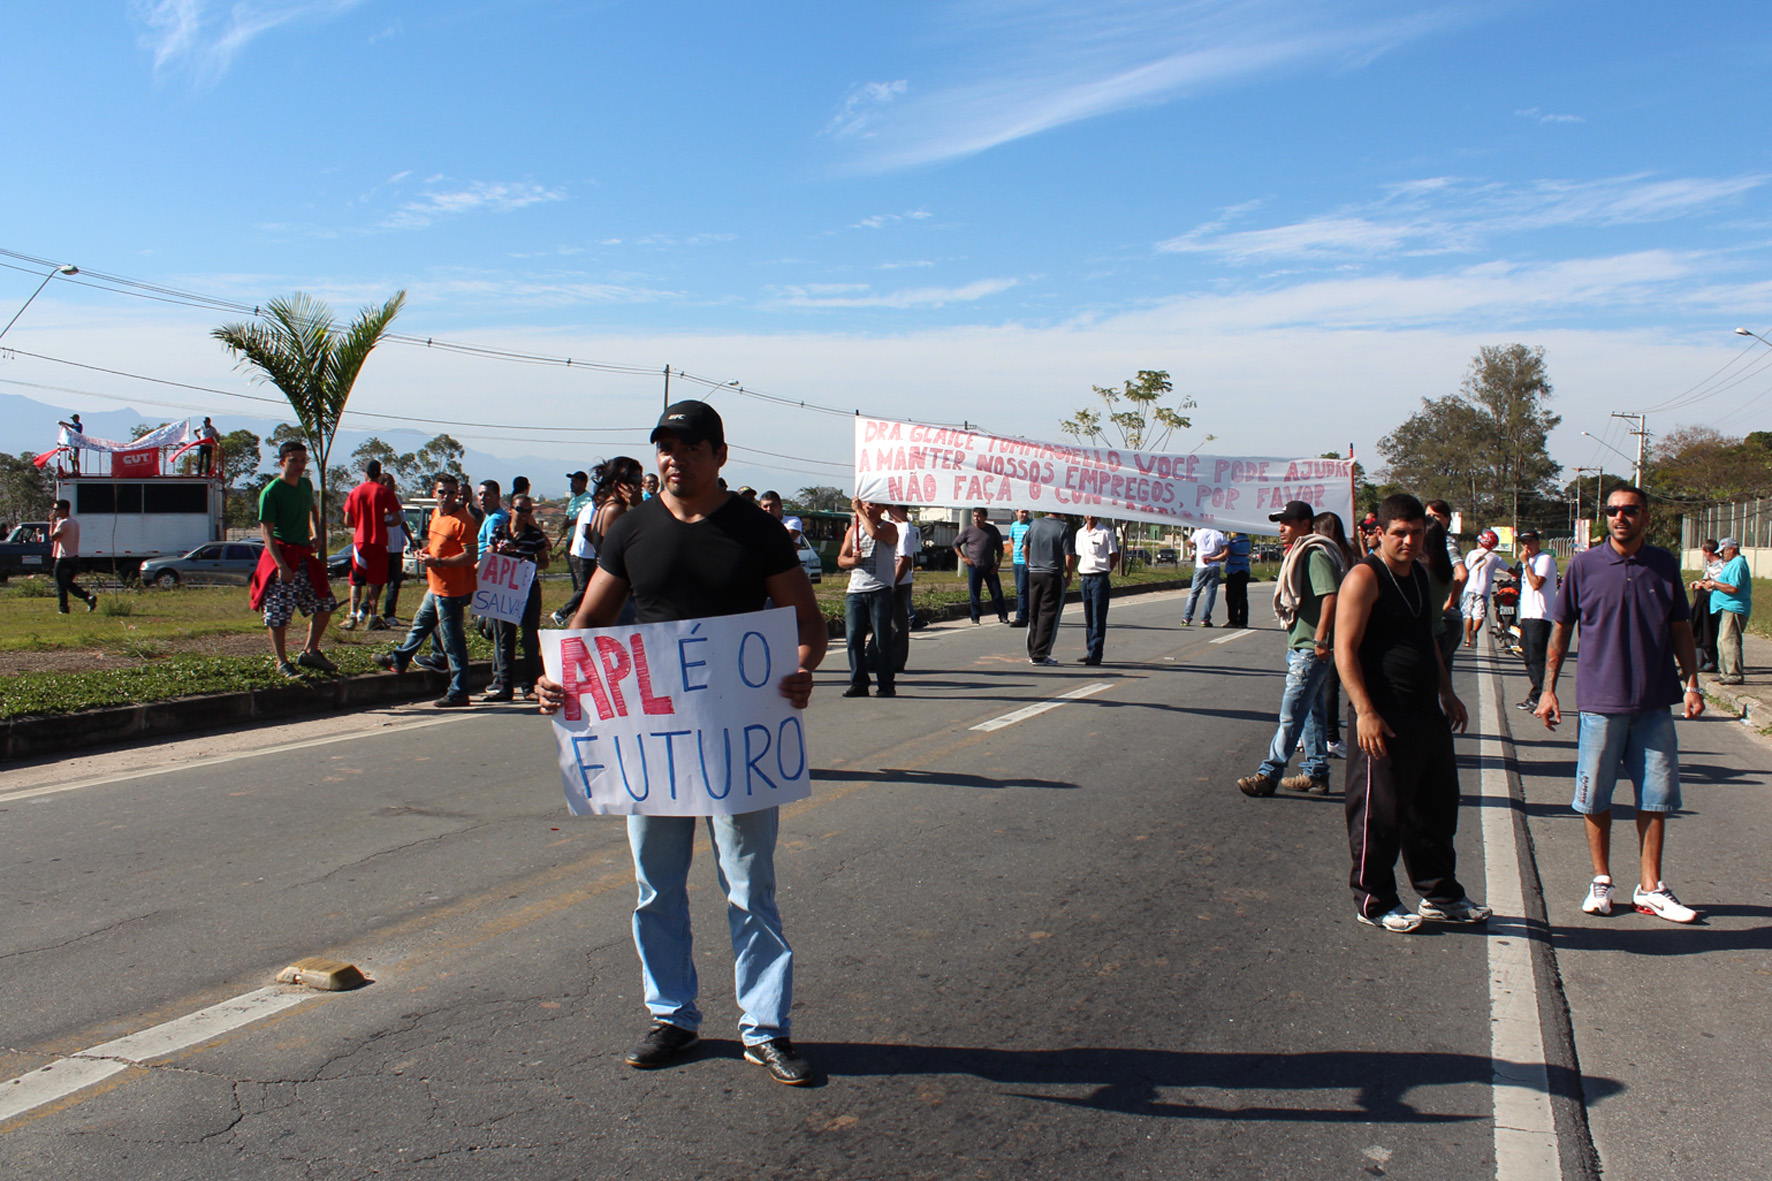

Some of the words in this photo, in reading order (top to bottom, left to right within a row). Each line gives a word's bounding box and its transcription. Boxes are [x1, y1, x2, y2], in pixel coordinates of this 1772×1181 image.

[123, 453, 149, 465] CUT
[859, 448, 871, 473] A
[876, 446, 967, 471] MANTER
[976, 454, 1055, 484] NOSSOS
[1065, 466, 1185, 509] EMPREGOS,
[1196, 484, 1240, 510] POR
[1256, 484, 1326, 510] FAVOR
[909, 424, 979, 451] GLAICE
[1133, 454, 1200, 483] VOCÊ
[1214, 459, 1269, 483] PODE
[887, 471, 937, 503] NÃO
[953, 474, 1012, 504] FAÇA
[482, 555, 520, 591] APL
[560, 632, 676, 722] APL
[678, 622, 708, 692] É
[737, 630, 772, 689] O
[571, 716, 805, 802] FUTURO
